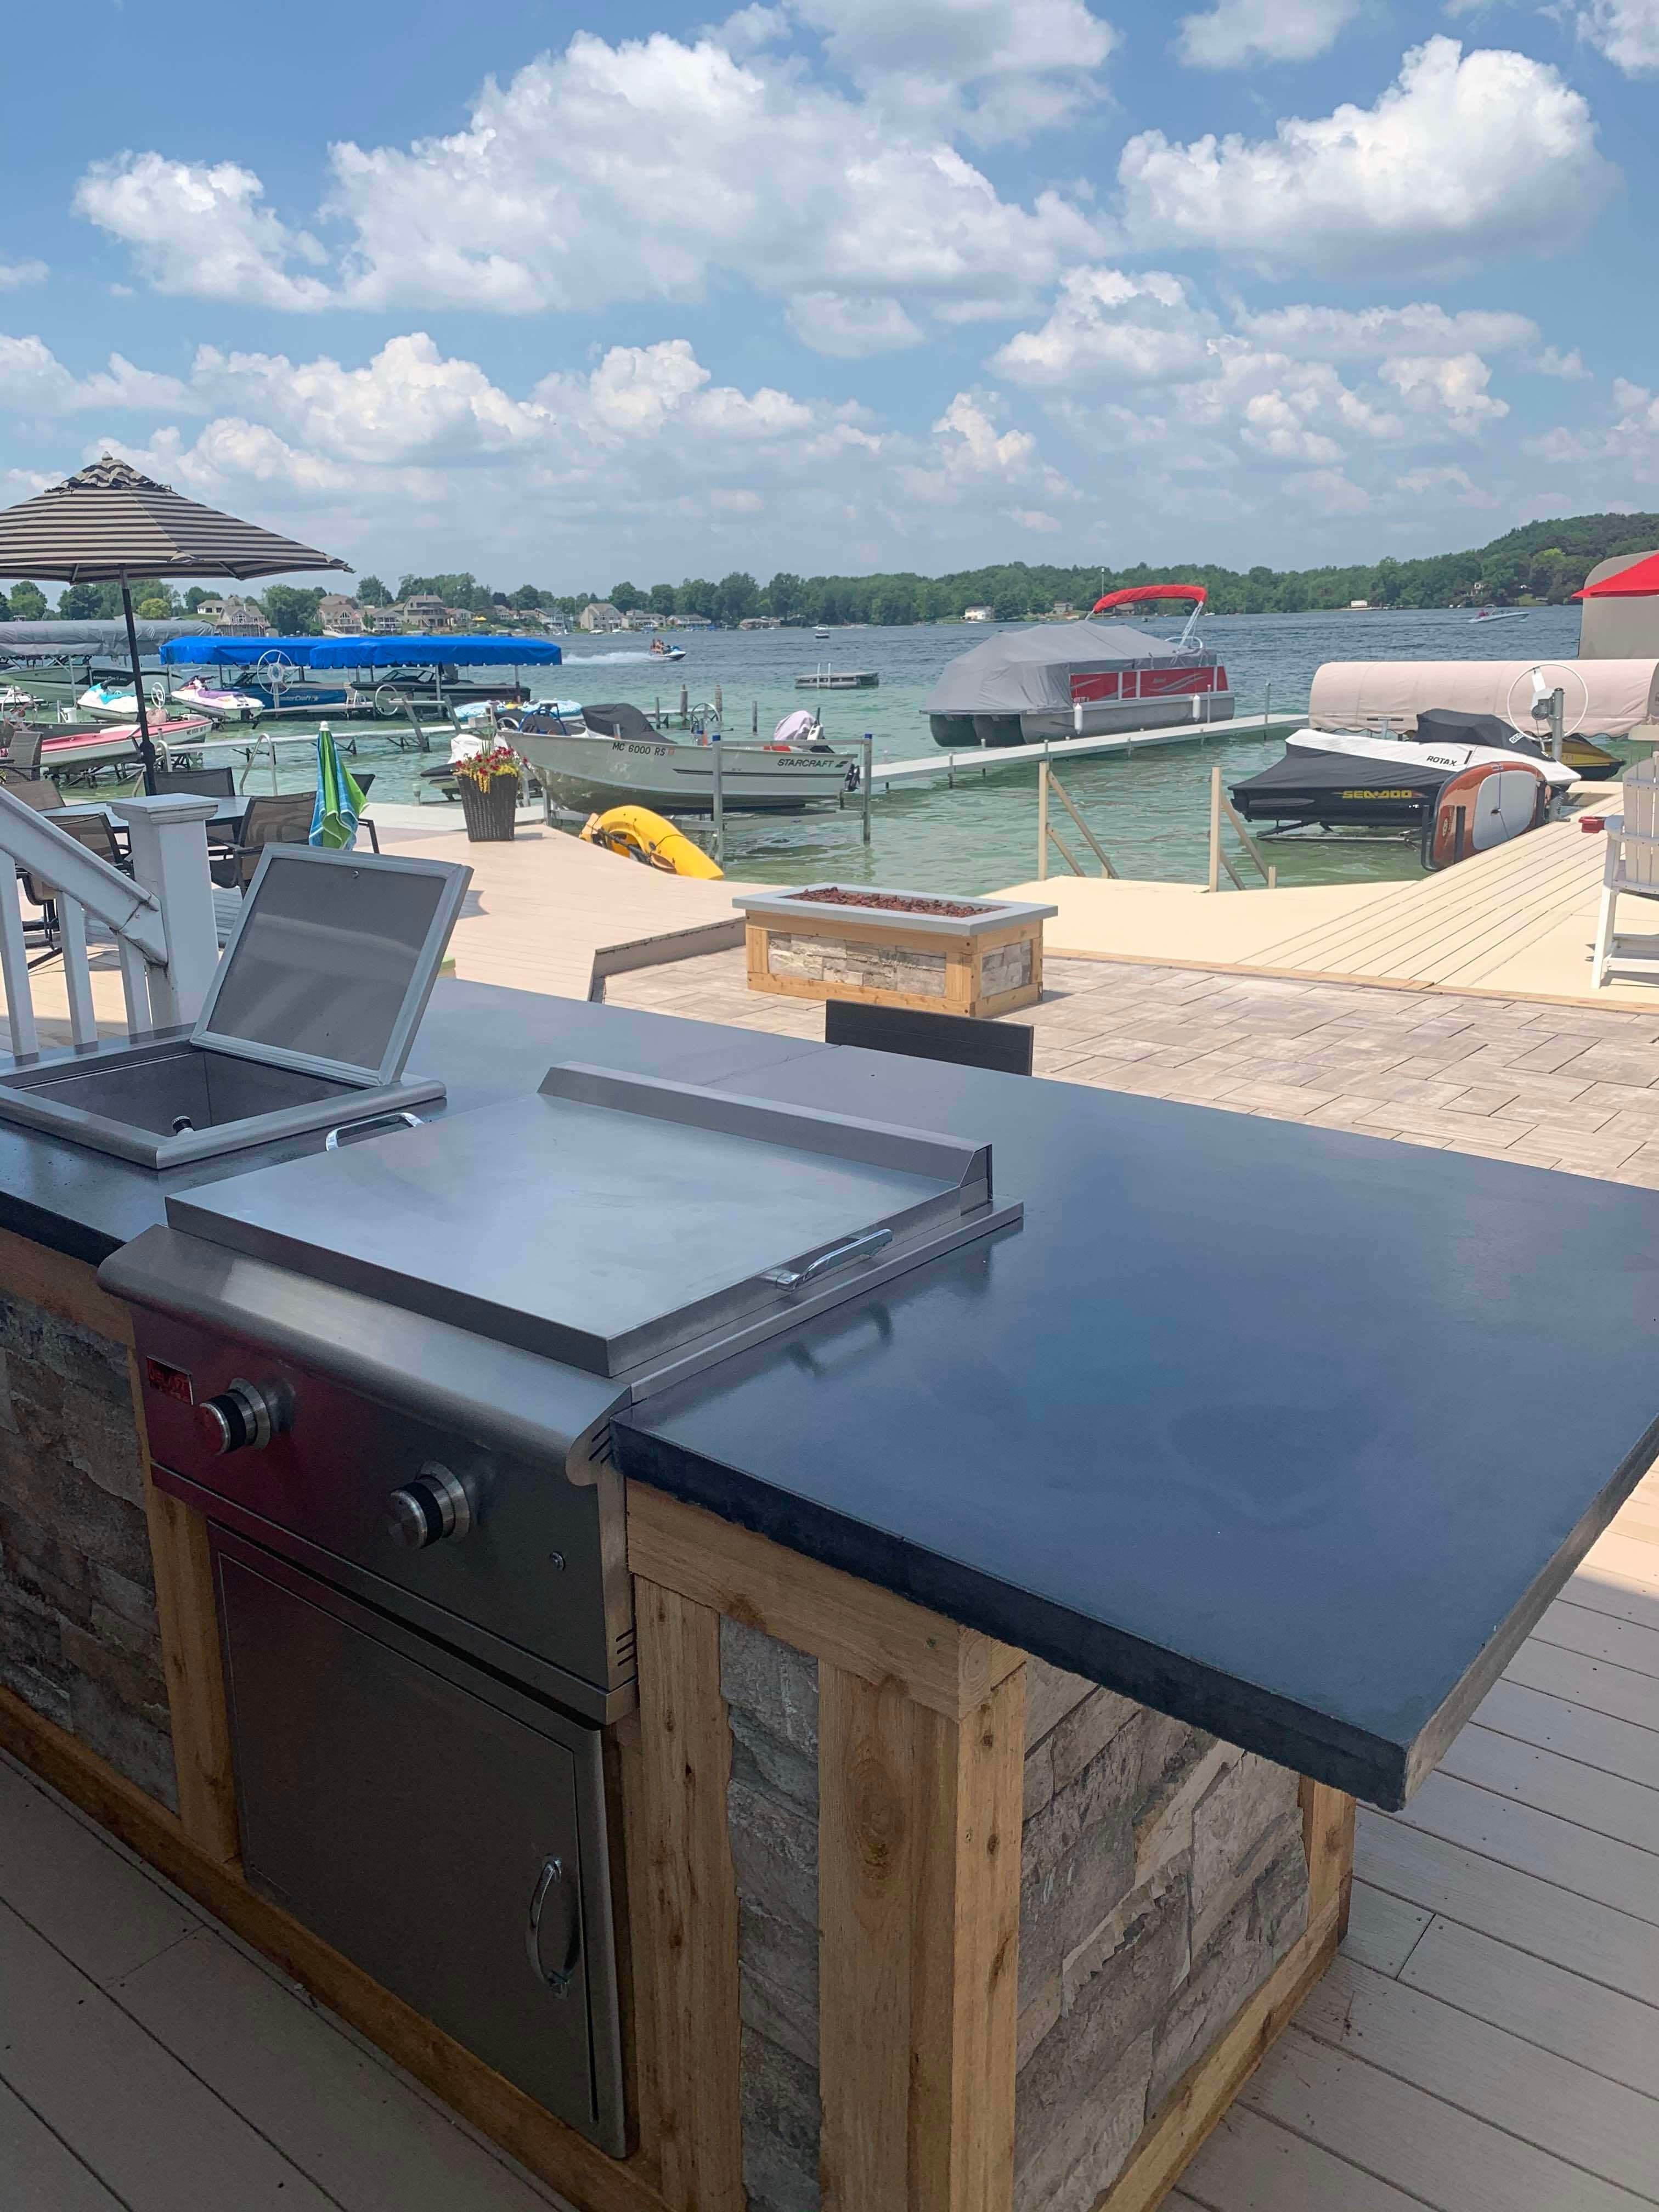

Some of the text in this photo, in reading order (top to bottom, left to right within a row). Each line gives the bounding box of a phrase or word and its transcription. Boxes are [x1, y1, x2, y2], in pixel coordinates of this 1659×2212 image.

[612, 742, 666, 756] MC 6000 RS
[777, 759, 834, 768] STARCRAFT
[1426, 755, 1457, 766] ROTAX
